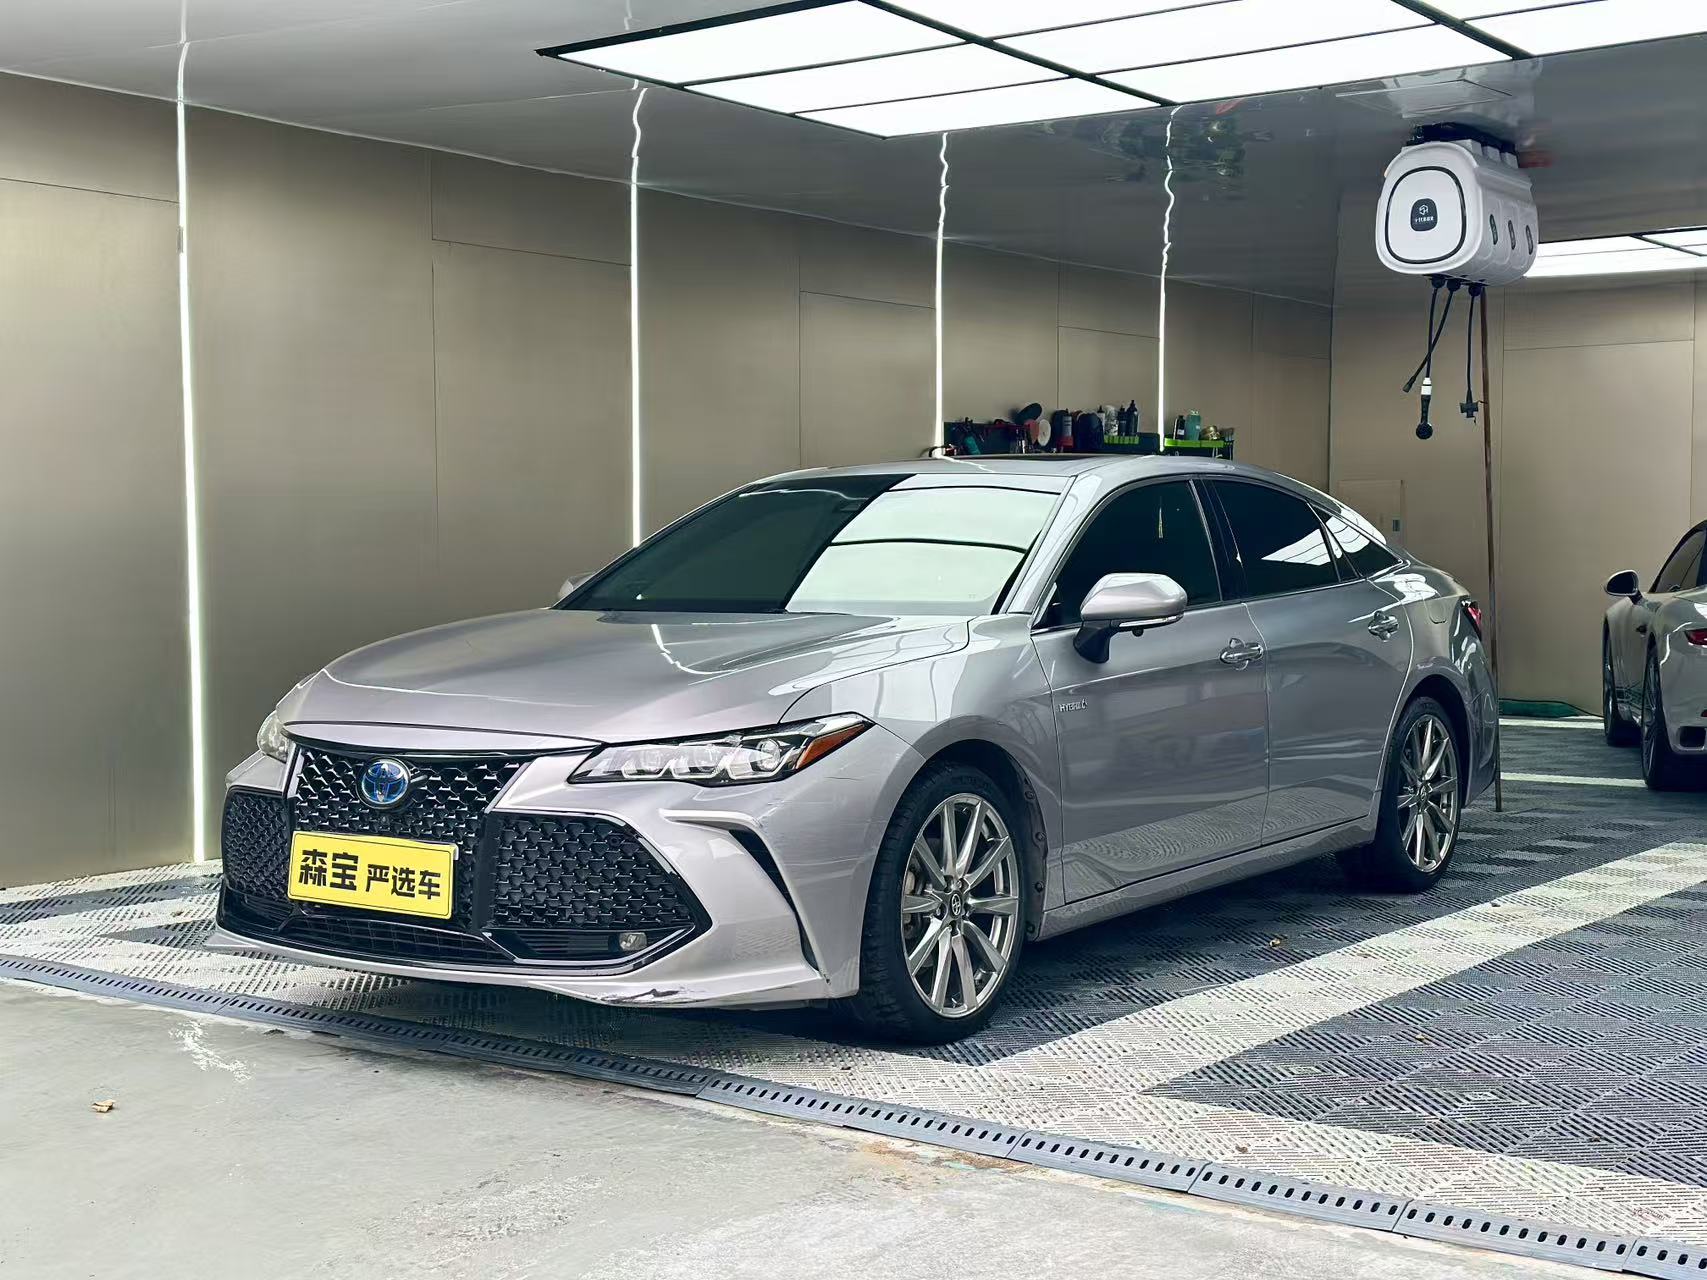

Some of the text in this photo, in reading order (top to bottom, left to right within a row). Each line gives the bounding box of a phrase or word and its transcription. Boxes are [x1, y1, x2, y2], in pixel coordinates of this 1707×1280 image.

[298, 848, 441, 900] 森宝 严选车
